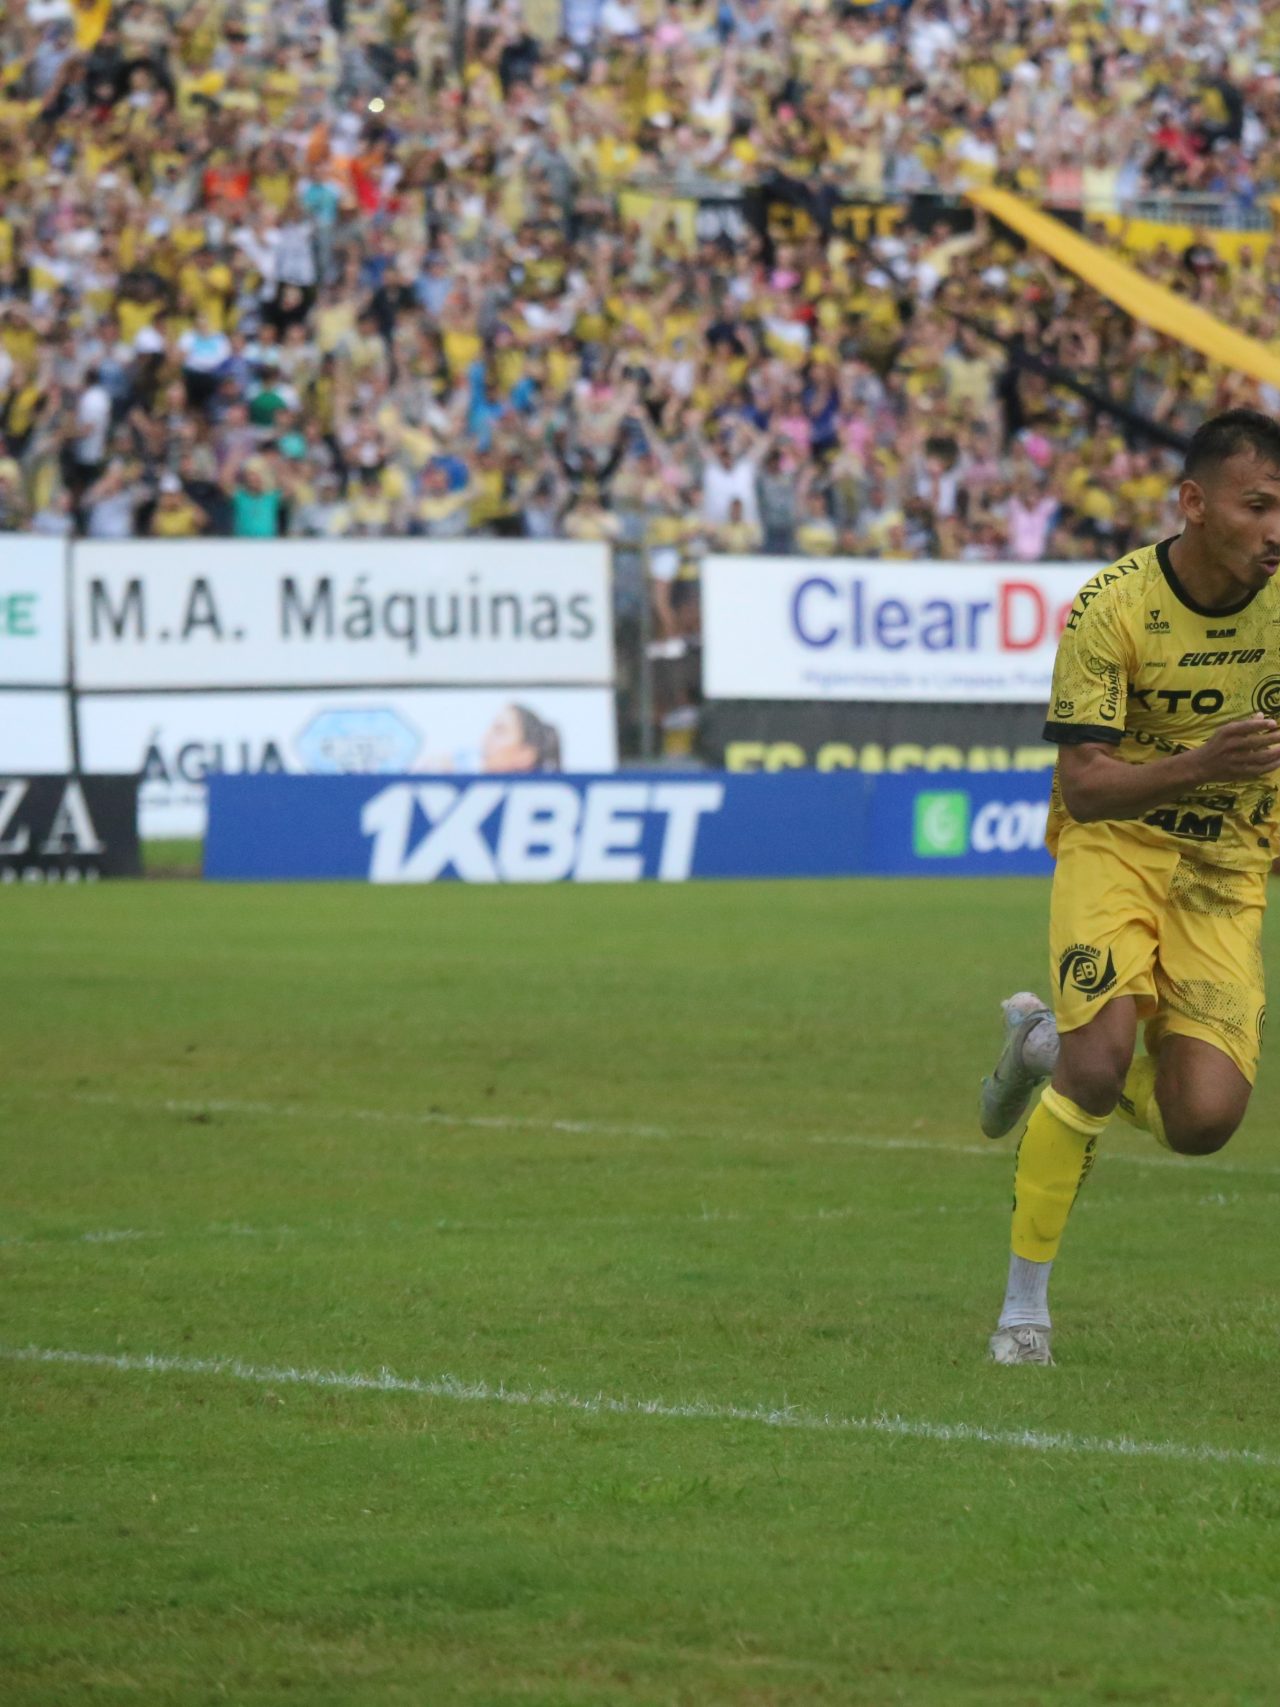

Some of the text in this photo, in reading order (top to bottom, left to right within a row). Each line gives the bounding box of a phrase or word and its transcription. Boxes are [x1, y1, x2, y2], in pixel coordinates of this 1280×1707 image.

[89, 574, 595, 654] M.A. Máquinas
[1066, 557, 1140, 631] HAVAN
[1178, 648, 1266, 668] EUCATUR
[1127, 683, 1225, 716] KTO
[142, 725, 287, 784] ÁGUA
[361, 782, 724, 882] 1XBET
